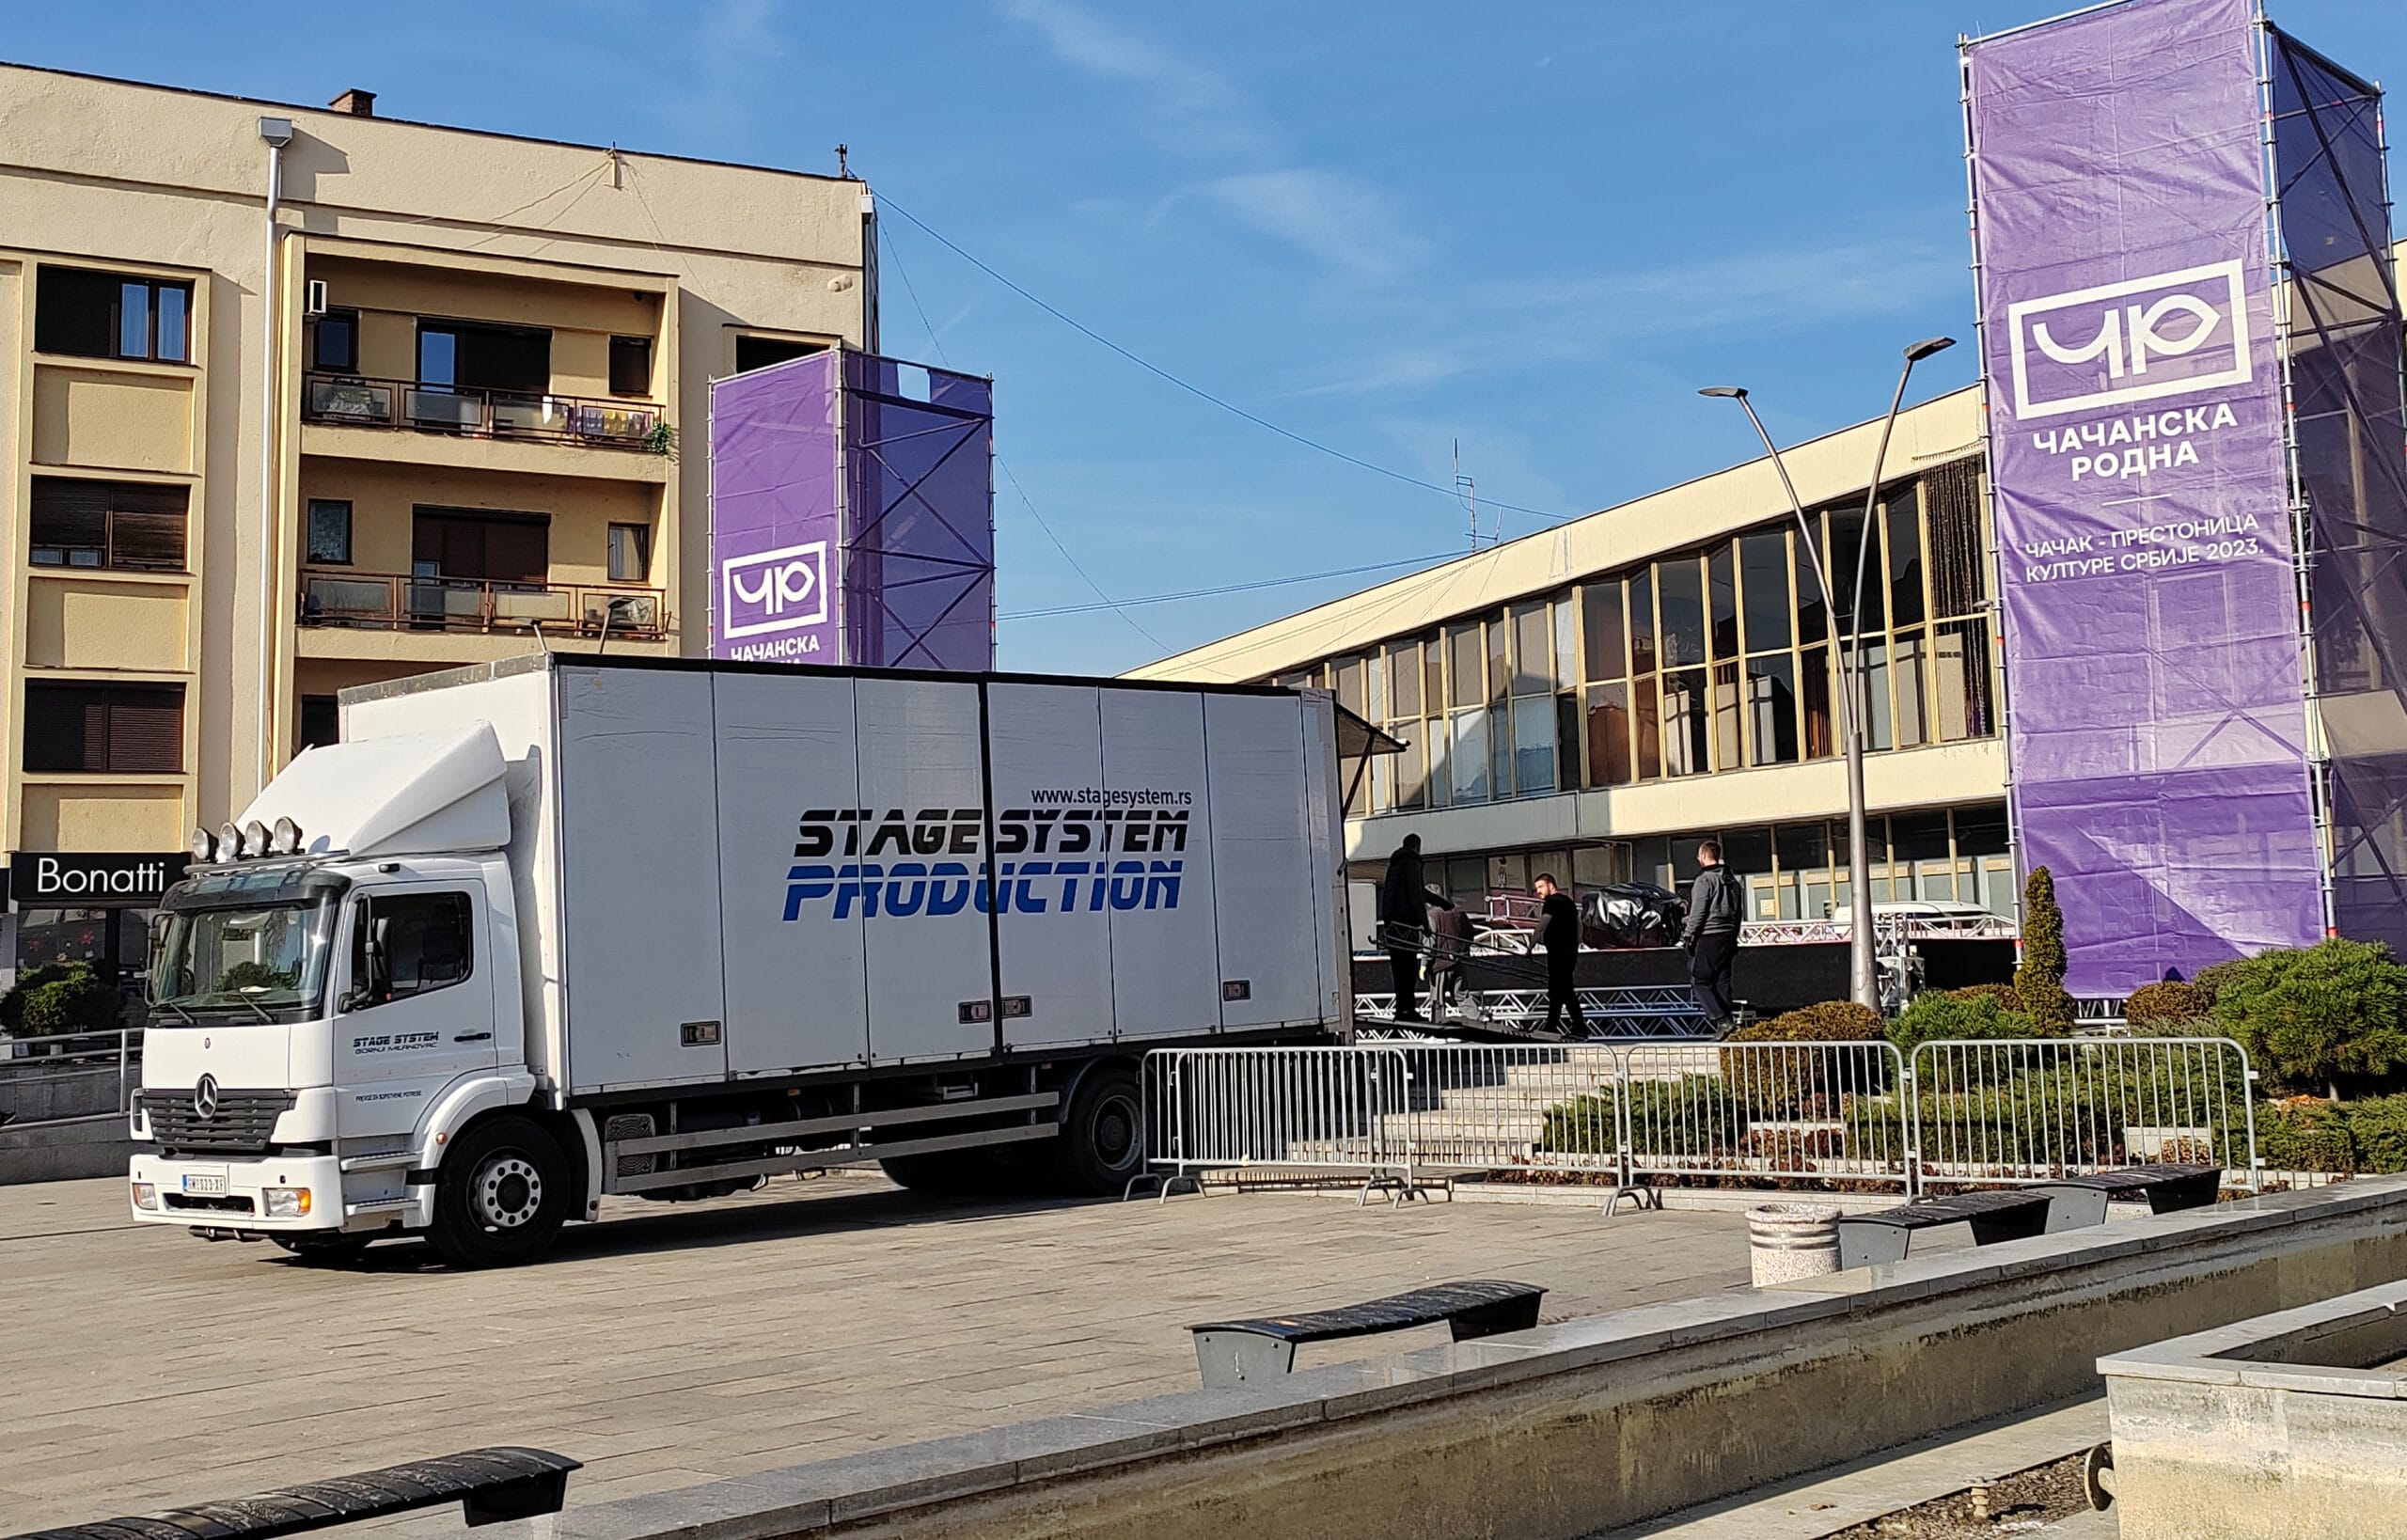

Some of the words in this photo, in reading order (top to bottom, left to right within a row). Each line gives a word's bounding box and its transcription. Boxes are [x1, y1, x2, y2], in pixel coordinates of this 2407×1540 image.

[2033, 402, 2238, 454] ЧАЧАНСКА
[2071, 440, 2199, 480] РОДНА
[2024, 535, 2094, 558] ЧАЧАК
[2111, 512, 2259, 548] ПРЕСТОНИЦА
[2025, 556, 2116, 583] КУЛТУРЕ
[2120, 546, 2199, 571] СРБИЈЕ
[2206, 538, 2264, 561] 2023.
[731, 635, 820, 661] ЧАЧАНСКА
[1031, 787, 1191, 808] www.stagesystem.rs
[794, 809, 983, 857] STAGE
[995, 809, 1190, 855] SYSTEM
[38, 857, 165, 893] Bonatti
[782, 859, 1184, 921] PRODUCTION
[354, 1036, 390, 1047] STAGE
[394, 1031, 439, 1044] SYSTEM
